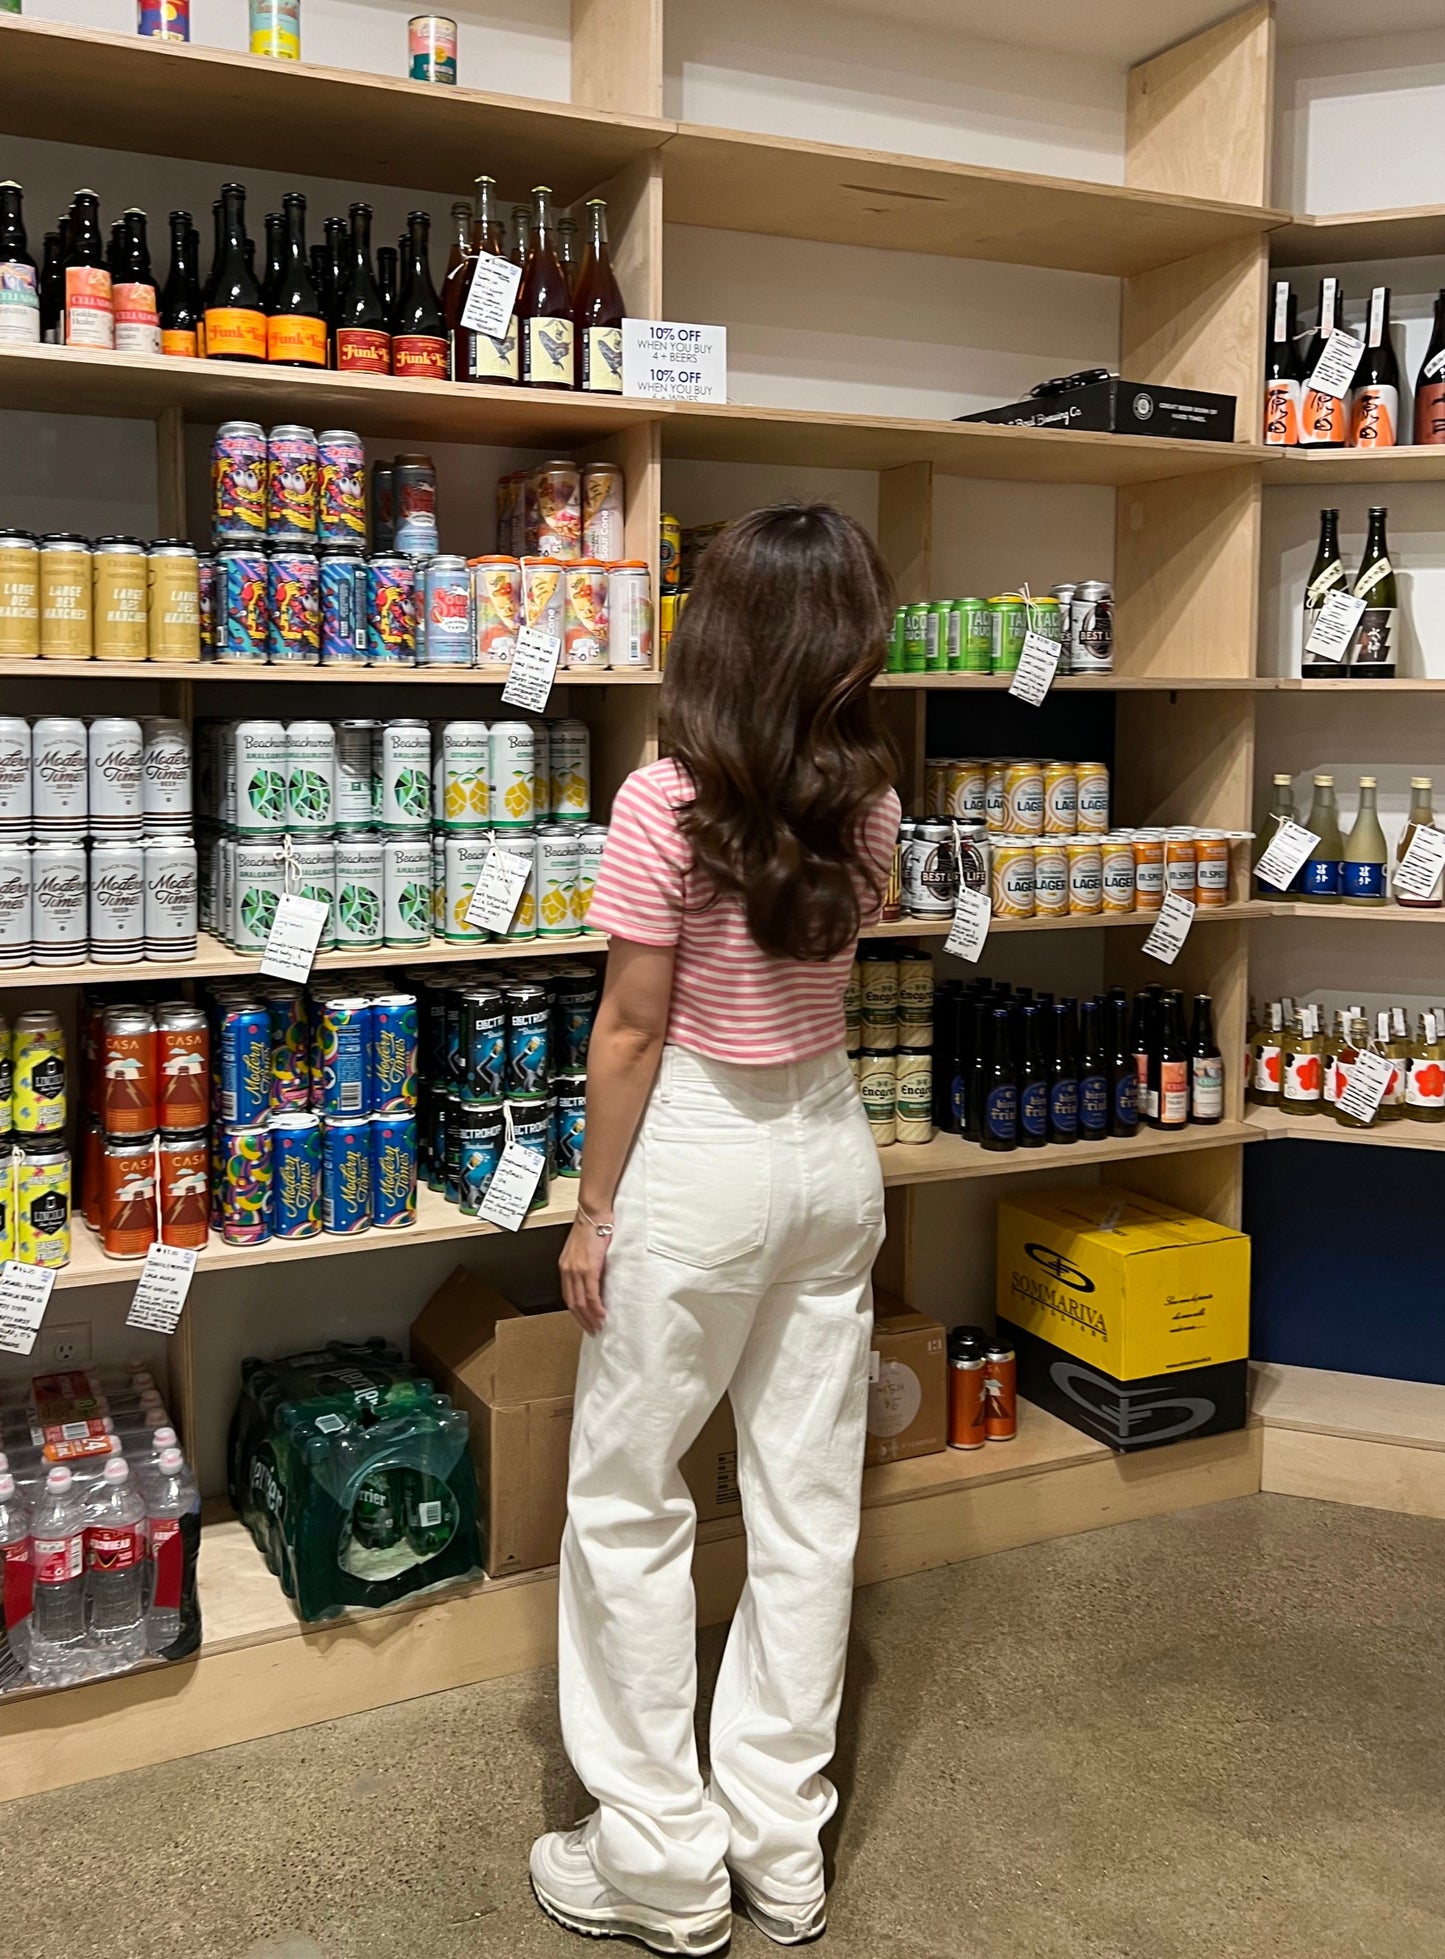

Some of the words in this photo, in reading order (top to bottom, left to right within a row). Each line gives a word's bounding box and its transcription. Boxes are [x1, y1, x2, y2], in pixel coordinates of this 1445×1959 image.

[650, 327, 675, 340] 10%
[678, 329, 701, 341] OFF
[341, 344, 380, 361] Funk
[637, 340, 667, 350] WHEN
[670, 342, 691, 352] YOU
[694, 344, 712, 354] BUY
[395, 351, 432, 368] Funk
[670, 352, 698, 363] BEERS
[650, 369, 675, 382] 10%
[678, 371, 701, 383] OFF
[637, 382, 667, 392] WHEN
[670, 384, 691, 394] YOU
[694, 385, 712, 395] BUY
[600, 510, 609, 536] Cone
[905, 615, 927, 630] ACO
[904, 629, 927, 641] RUCK
[1081, 631, 1103, 640] BEST
[1017, 801, 1043, 812] LAGE
[1081, 799, 1108, 810] LAGE
[922, 872, 946, 882] BEST
[1073, 878, 1101, 890] LAGE
[1008, 881, 1035, 892] LAGE
[166, 1035, 202, 1046] CASA
[375, 1030, 396, 1093] Modern
[242, 1041, 265, 1106] Modern
[340, 1150, 362, 1214] Modern
[378, 1145, 400, 1208] Modern
[280, 1154, 301, 1218] Modern
[1011, 1271, 1107, 1333] SOMMARIVA
[358, 1488, 387, 1507] rrier
